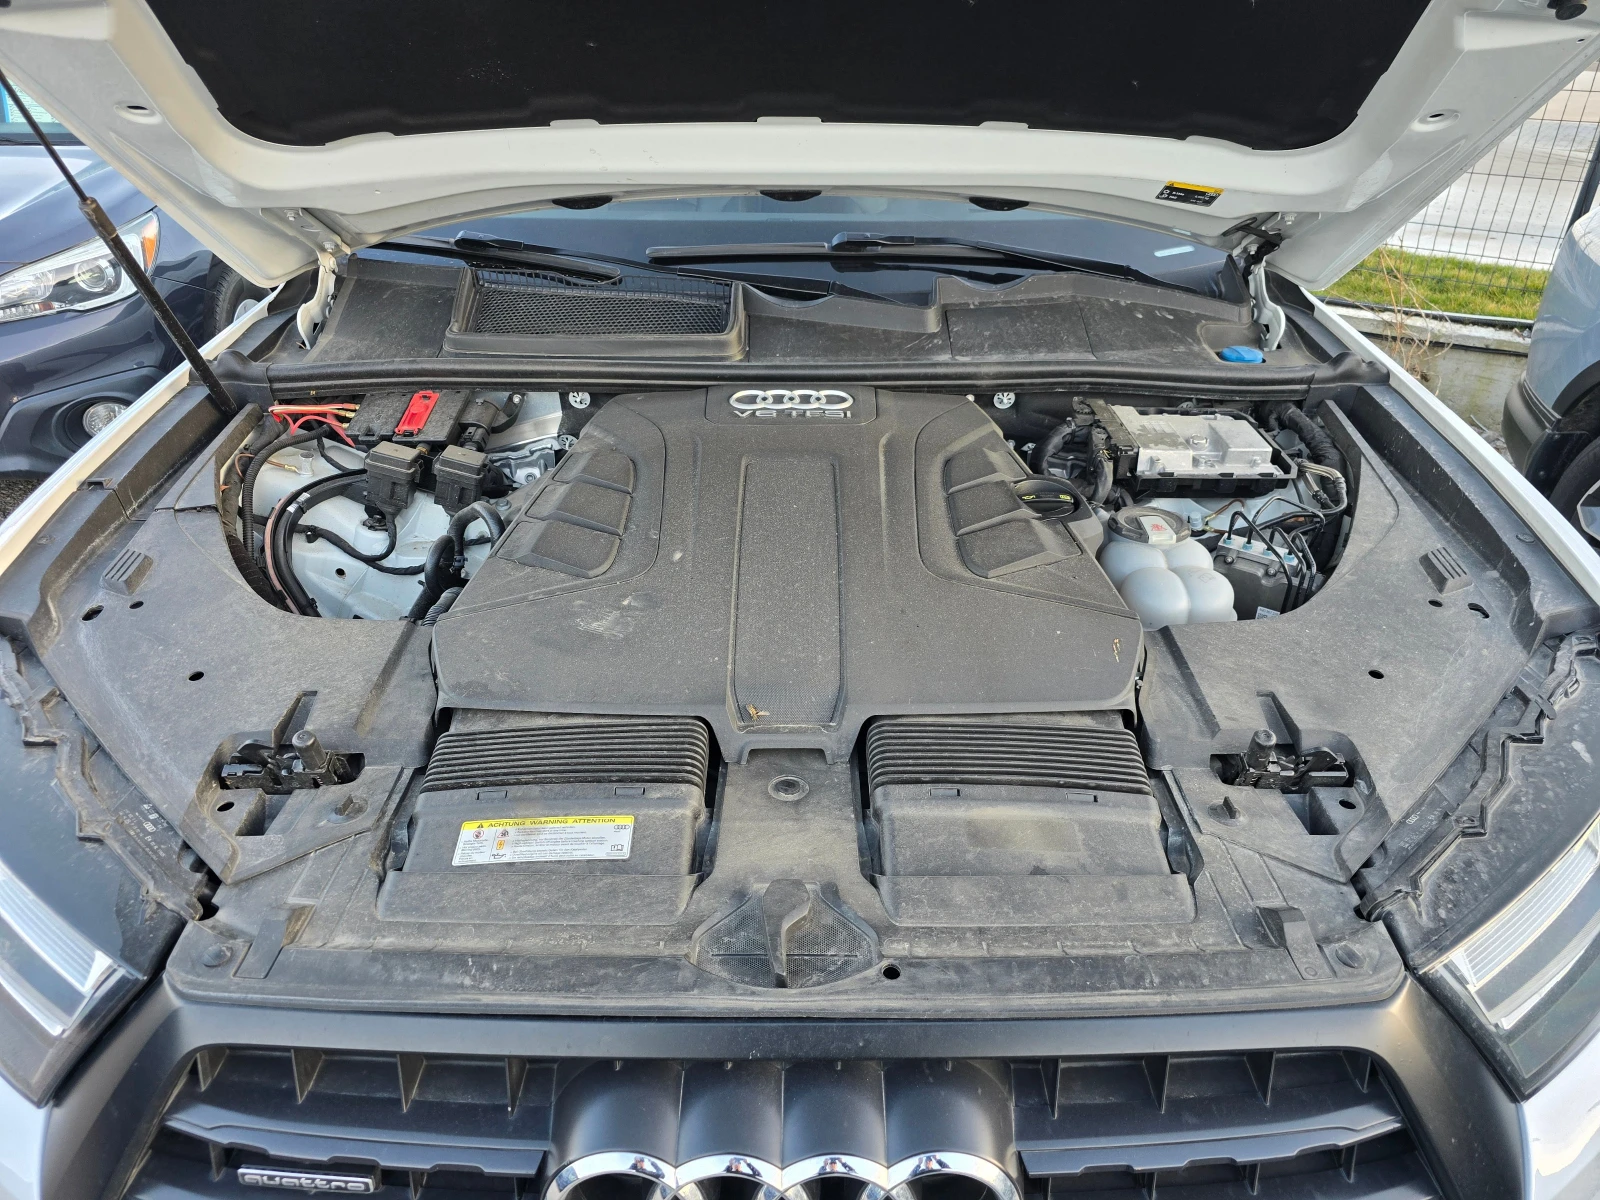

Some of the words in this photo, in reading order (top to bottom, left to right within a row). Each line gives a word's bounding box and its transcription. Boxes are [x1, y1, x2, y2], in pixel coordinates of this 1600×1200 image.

[733, 410, 777, 418] V6
[784, 409, 852, 418] TFSI
[487, 820, 526, 828] ACHTUNG
[244, 1174, 365, 1191] quattro
